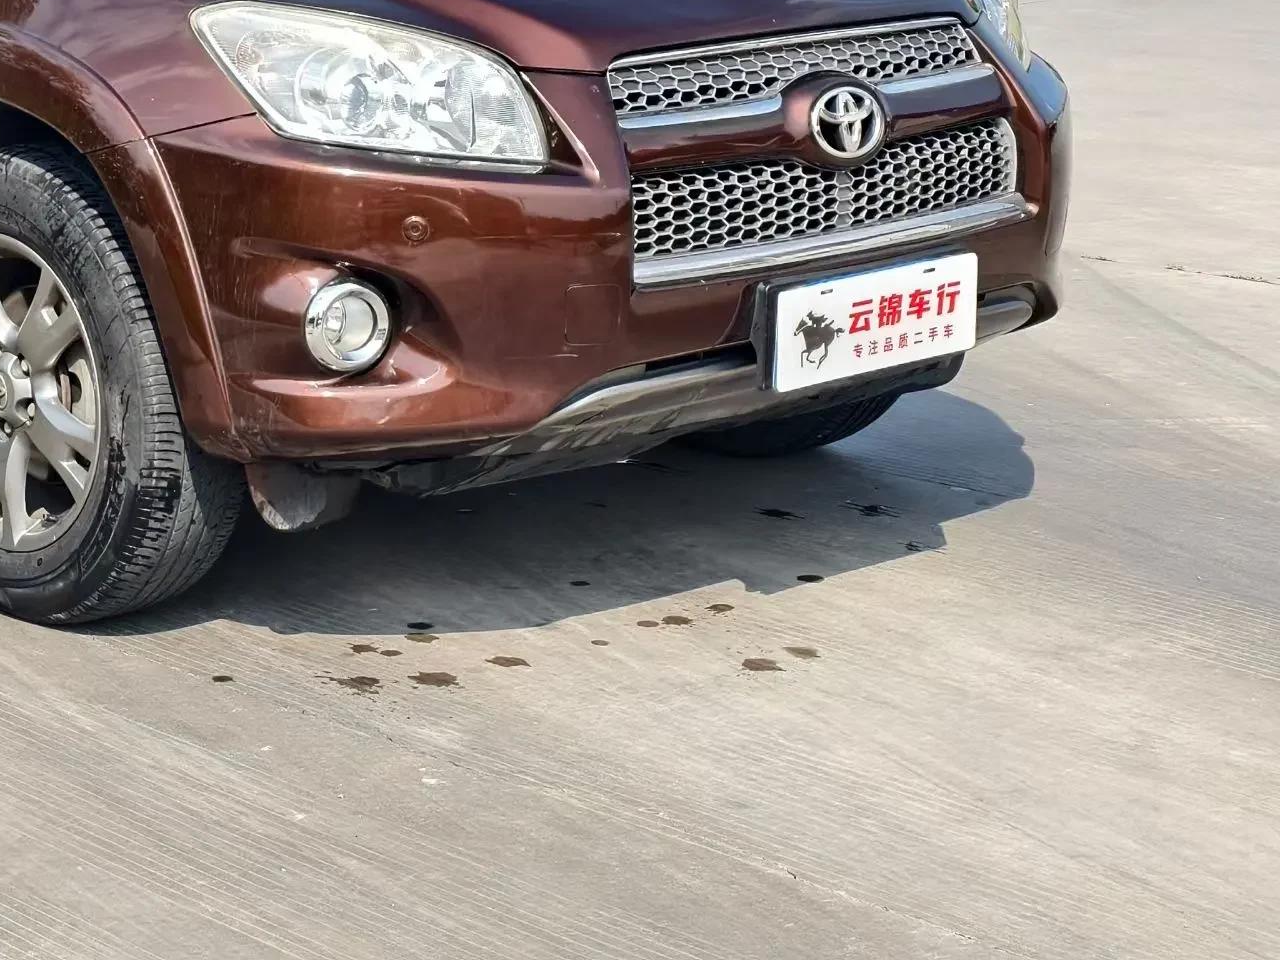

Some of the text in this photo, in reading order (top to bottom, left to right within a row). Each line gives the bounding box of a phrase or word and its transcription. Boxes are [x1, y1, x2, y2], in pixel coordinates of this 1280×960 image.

[848, 280, 961, 335] 云锦车行
[852, 323, 955, 359] 专注品质二手车
